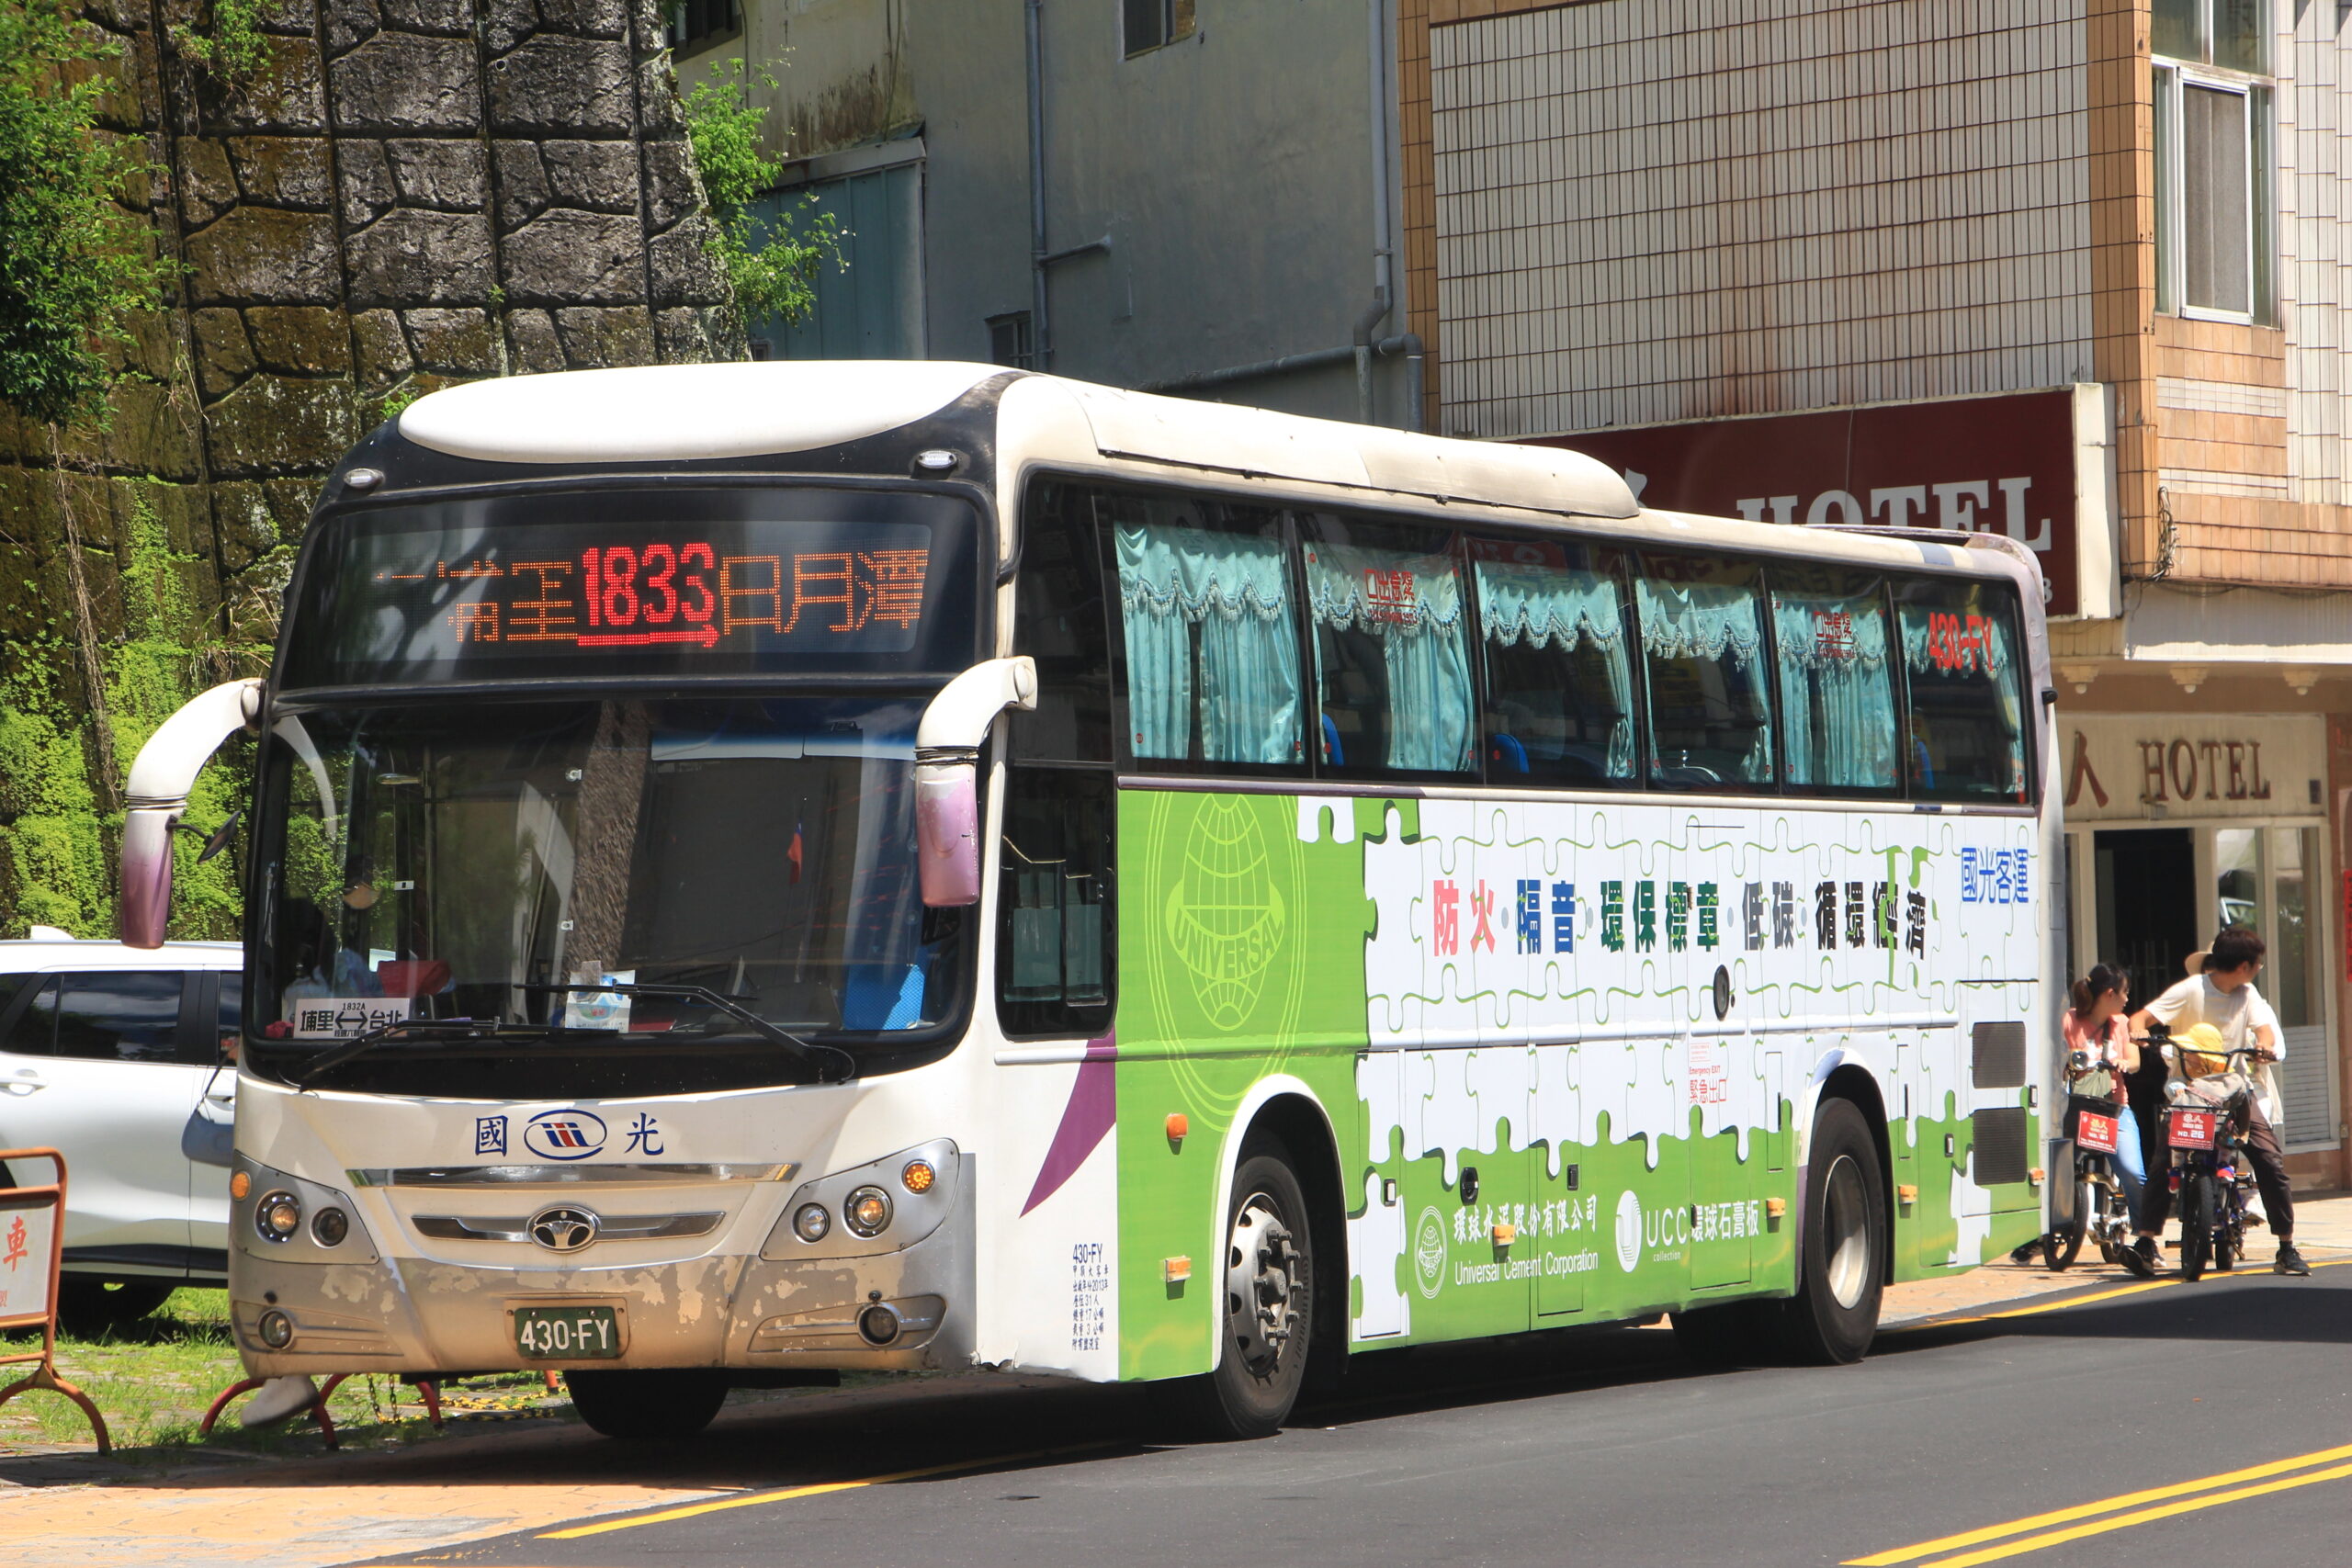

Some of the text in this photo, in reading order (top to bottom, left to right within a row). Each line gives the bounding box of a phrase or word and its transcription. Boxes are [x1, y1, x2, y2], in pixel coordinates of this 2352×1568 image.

[582, 543, 714, 626] 1833
[720, 550, 929, 635] 日月潭
[1928, 612, 1993, 671] 430-FY
[2138, 739, 2271, 802] HOTEL
[1961, 847, 2030, 904] 國光客運
[1173, 906, 1284, 980] UNIVERSAL
[1433, 879, 1927, 961] 防火 隔音 環保標章 低碳 循環經濟
[300, 1010, 334, 1032] 埔里
[342, 1002, 366, 1011] 1832A
[1689, 1066, 1710, 1076] Emergency
[1690, 1078, 1726, 1103] 緊急出口
[1453, 1193, 1597, 1246] 環球水泥股份有限公司
[1646, 1206, 1687, 1247] UCC
[1690, 1200, 1759, 1242] 環球石膏板
[1454, 1258, 1499, 1286] Universal
[1504, 1254, 1542, 1280] Cement
[1545, 1247, 1599, 1280] Corporation
[1653, 1249, 1681, 1263] collection
